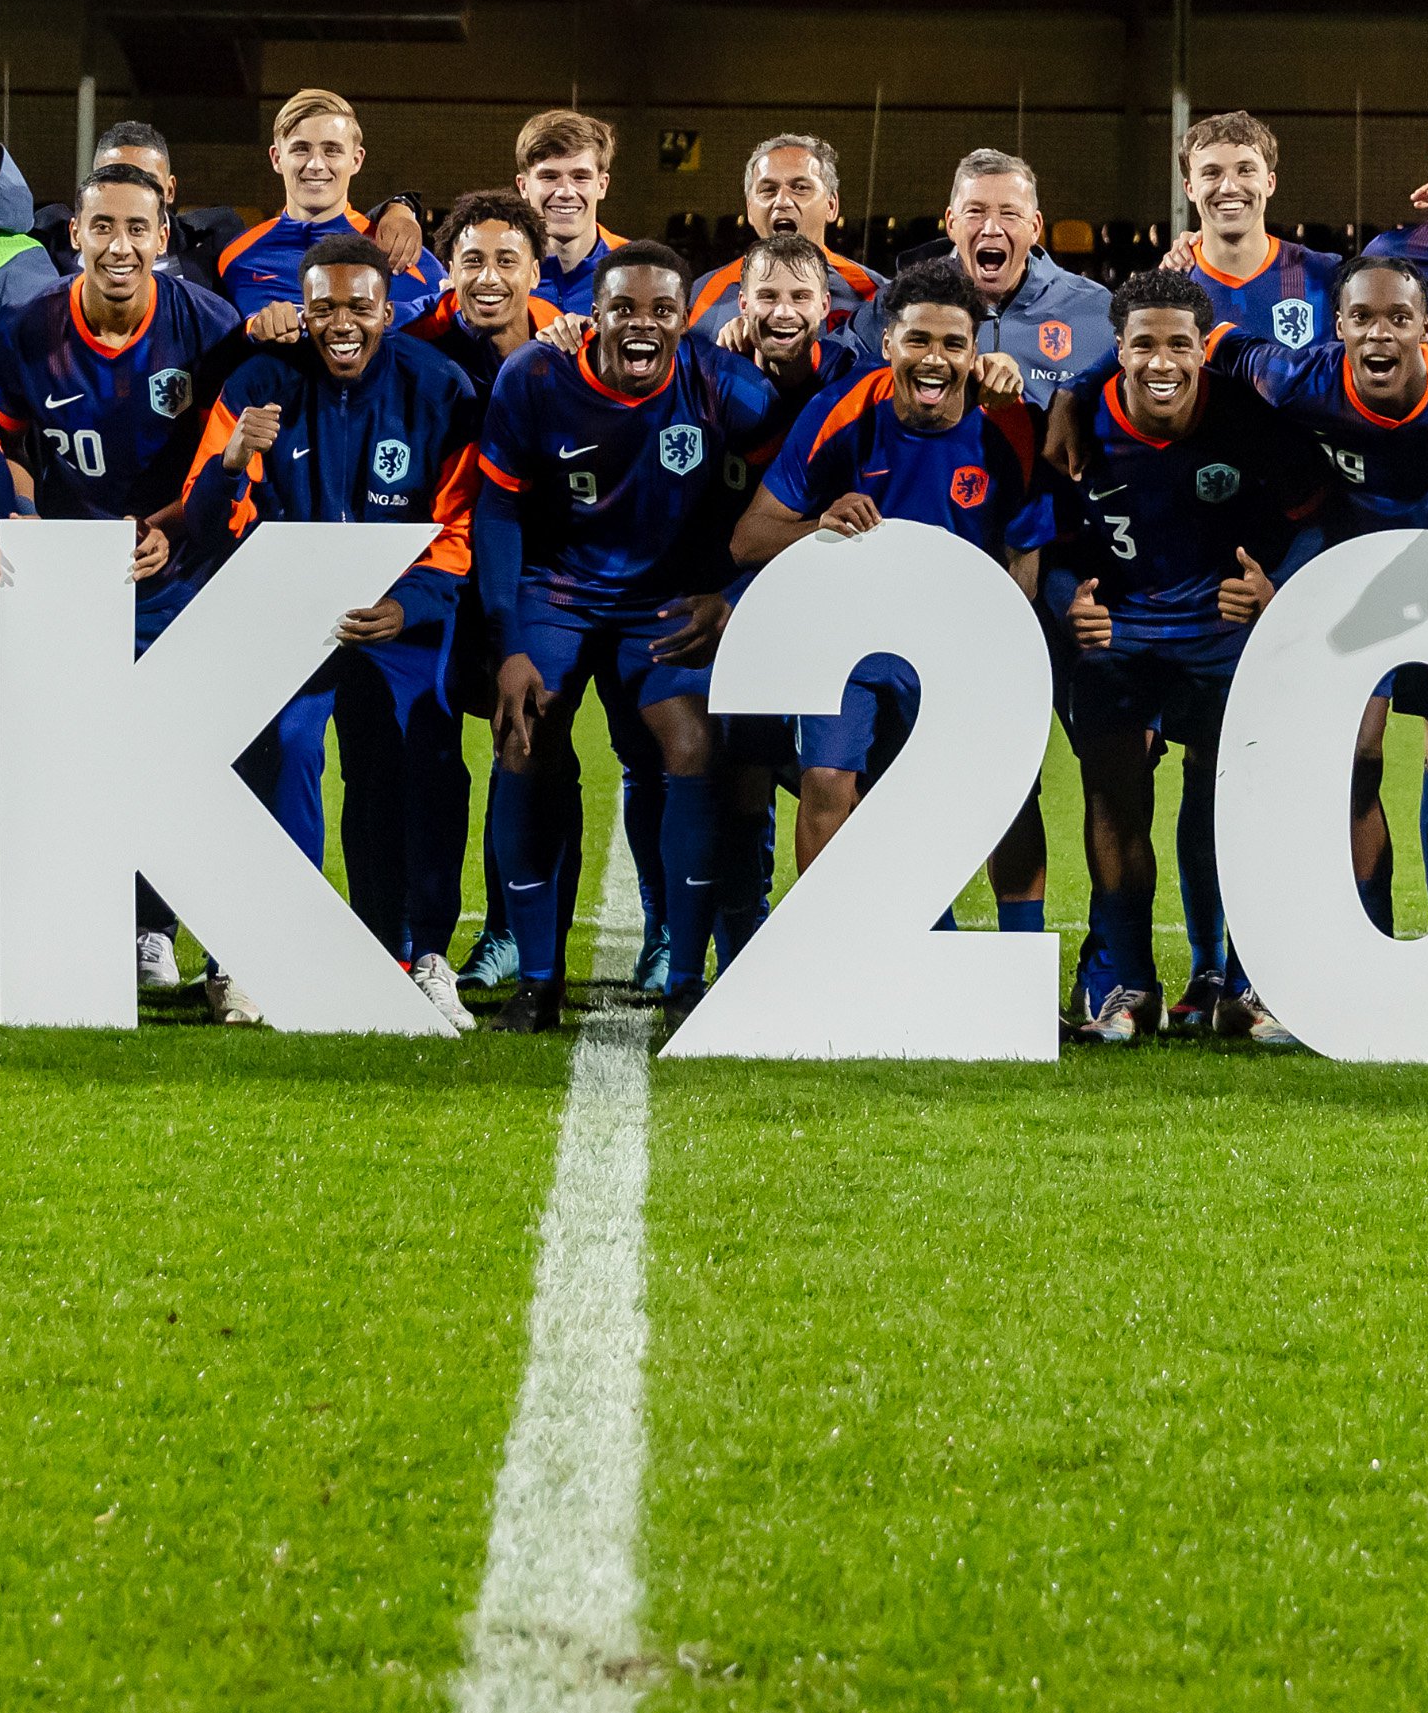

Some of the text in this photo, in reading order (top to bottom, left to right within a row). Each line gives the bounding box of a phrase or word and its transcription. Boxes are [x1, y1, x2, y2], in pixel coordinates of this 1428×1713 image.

[1031, 369, 1057, 381] ING
[43, 428, 106, 477] 20
[569, 471, 598, 505] 9
[1103, 515, 1138, 560] 3
